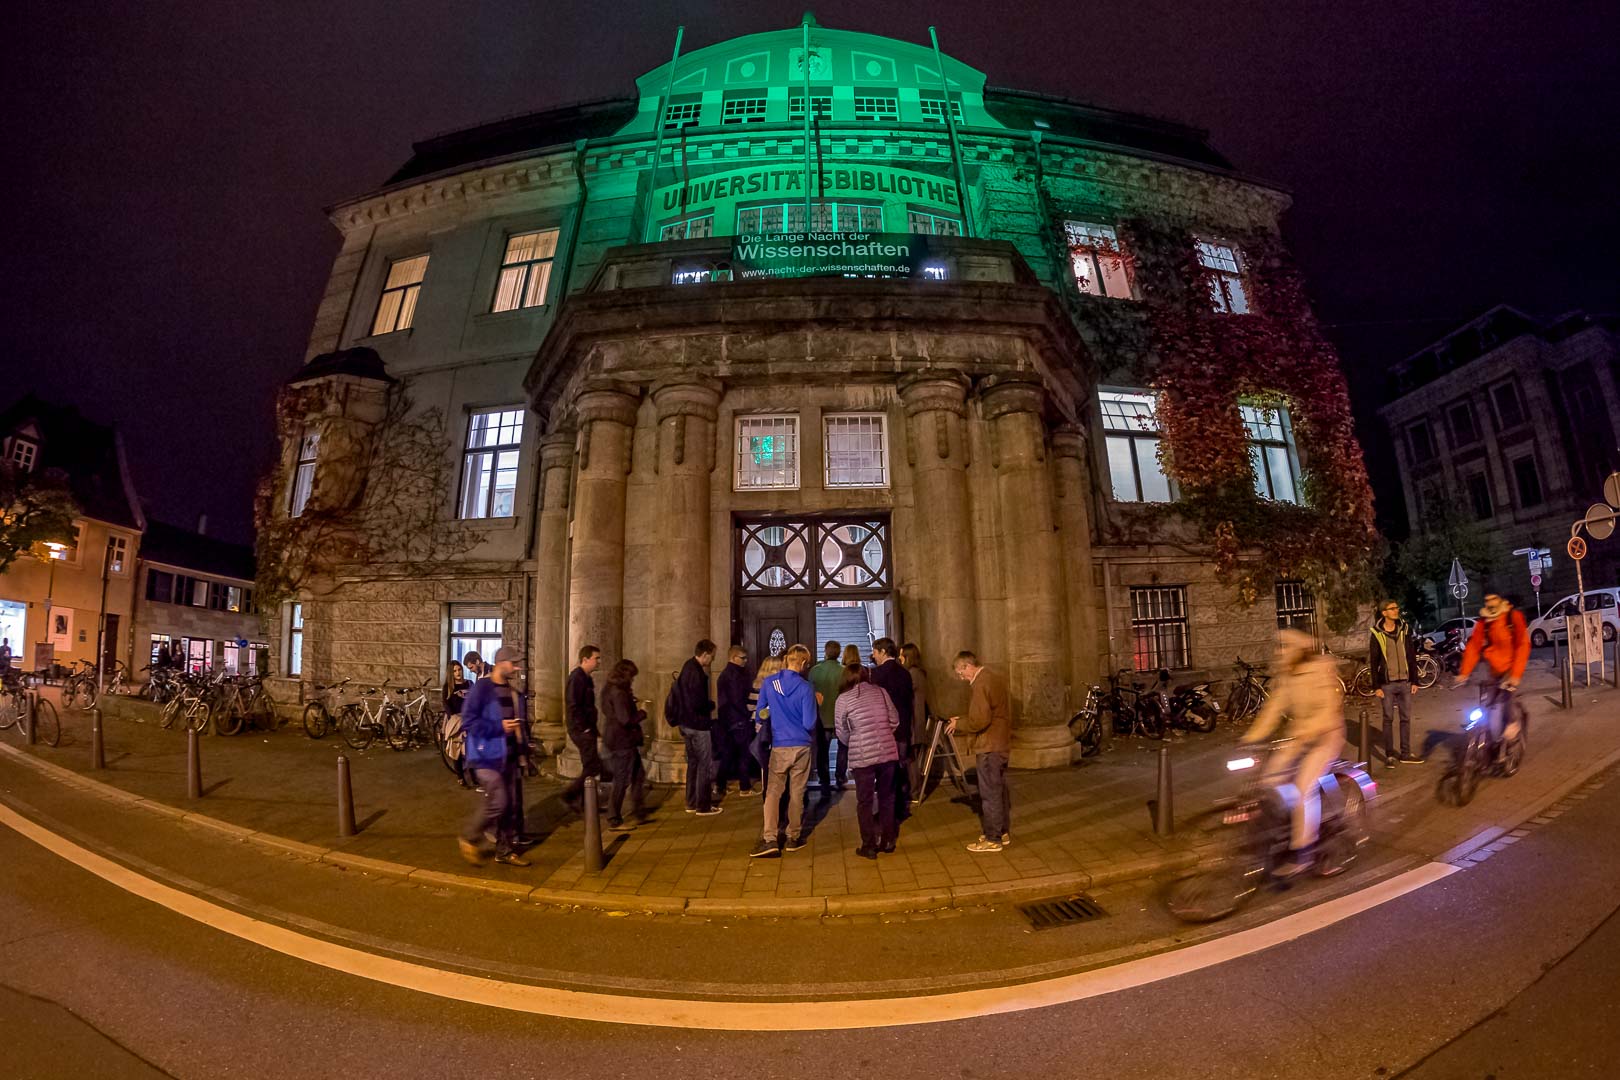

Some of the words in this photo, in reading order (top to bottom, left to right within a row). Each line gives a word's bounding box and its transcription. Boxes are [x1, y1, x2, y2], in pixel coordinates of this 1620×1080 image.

[663, 169, 966, 210] UNIVERSITÄTSBIBLIOTHE
[741, 234, 762, 244] Die
[765, 233, 806, 244] Lange
[808, 232, 845, 241] Nacht
[848, 232, 870, 241] der
[737, 242, 910, 260] Wissenschaften
[741, 264, 911, 278] www.nacht-der-wissenschaften.de
[1530, 551, 1536, 560] P
